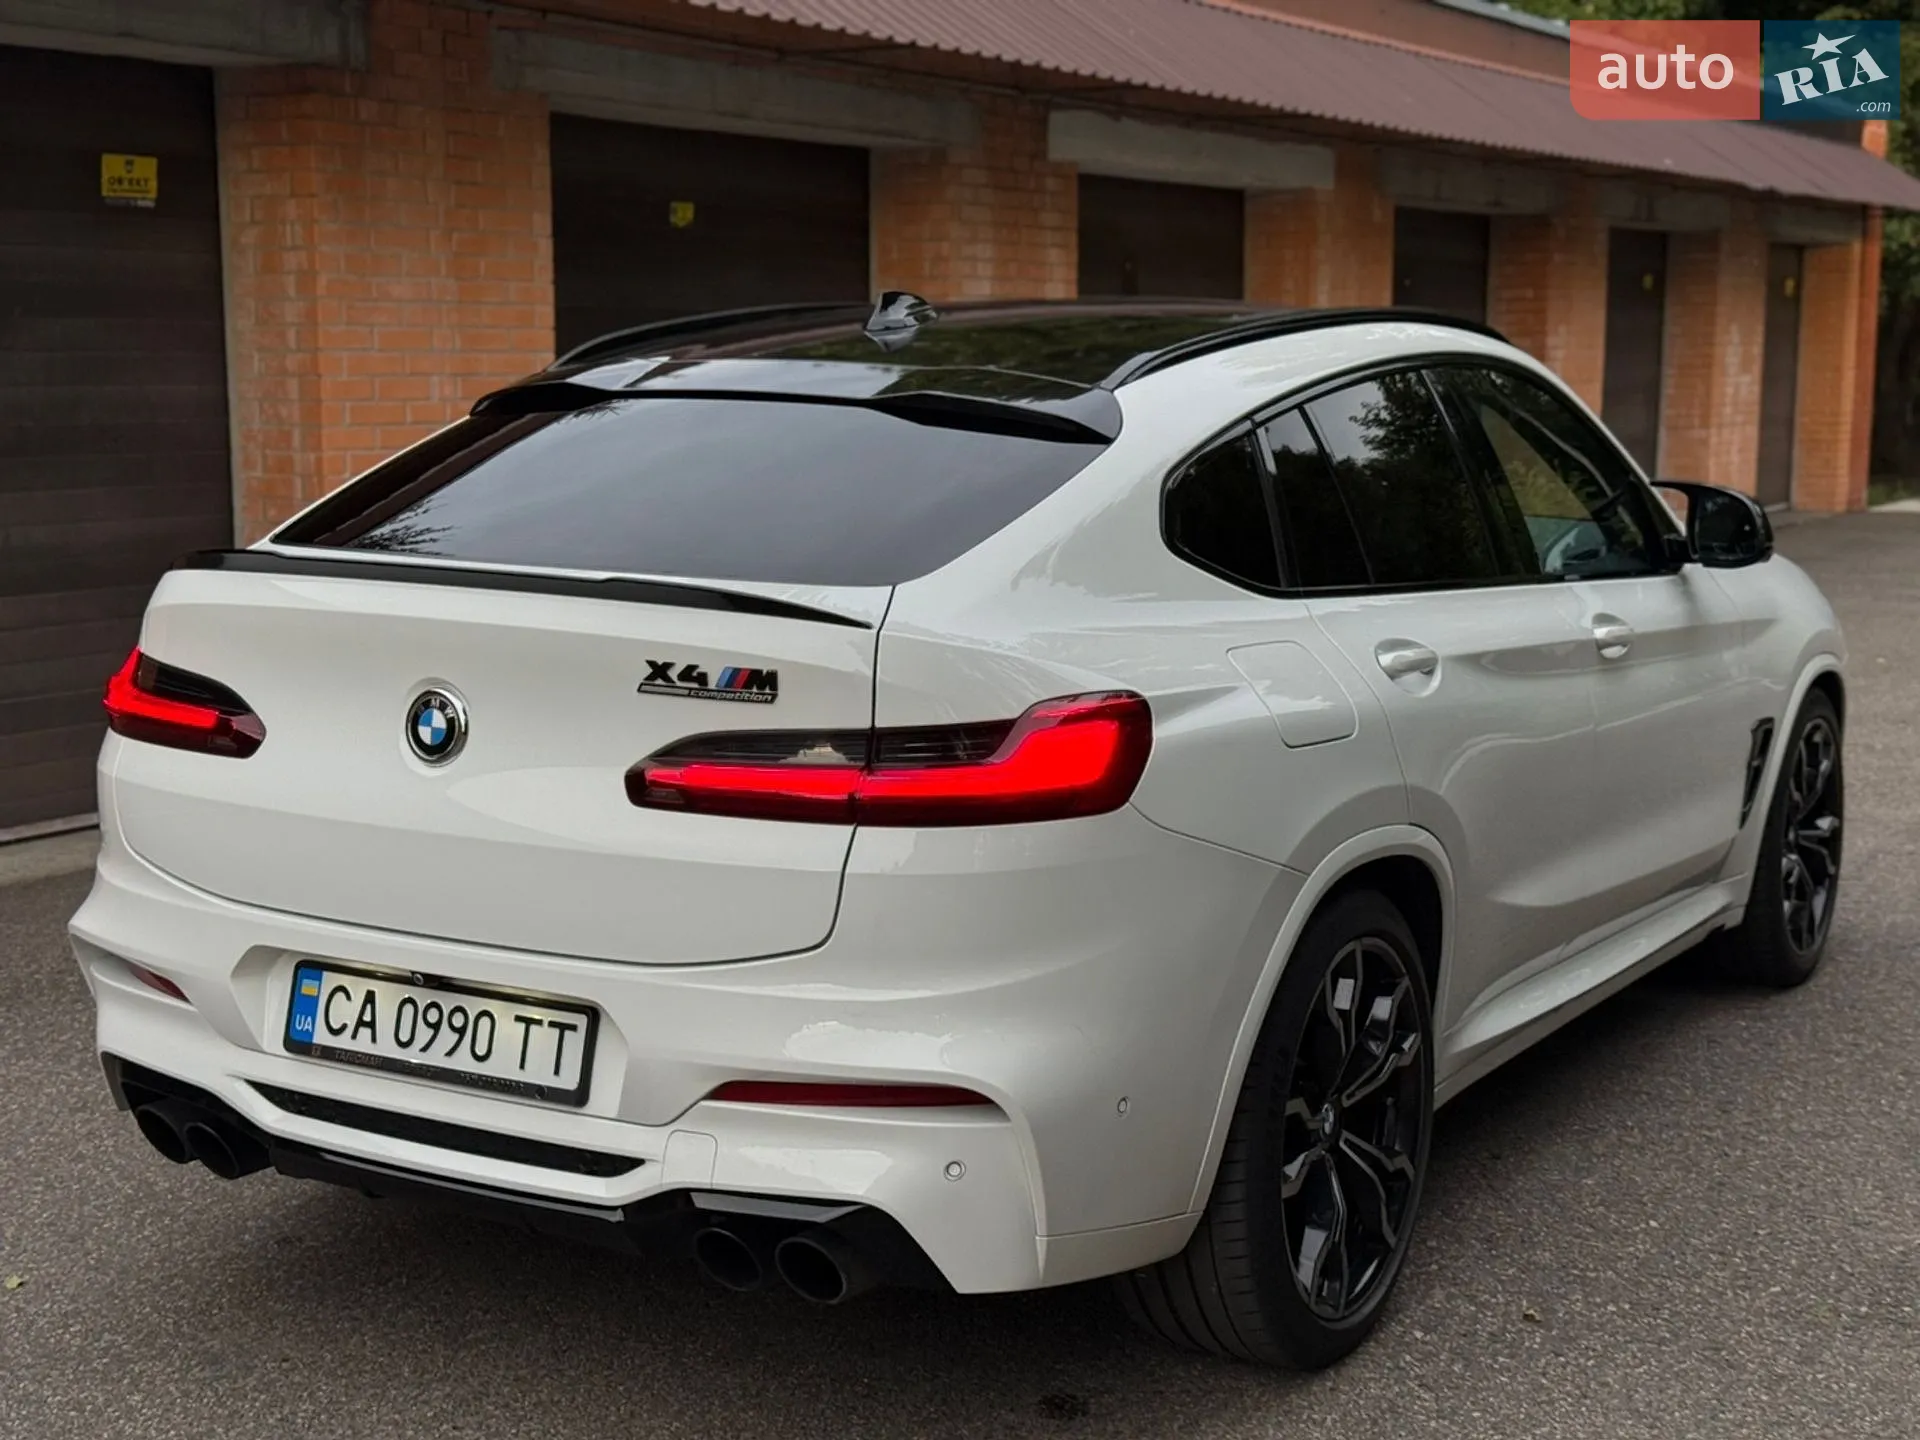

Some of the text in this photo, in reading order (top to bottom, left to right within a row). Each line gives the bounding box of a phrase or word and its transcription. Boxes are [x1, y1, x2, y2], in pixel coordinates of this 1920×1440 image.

[642, 659, 709, 688] X4
[690, 689, 772, 702] competition
[295, 1014, 313, 1033] UA
[324, 984, 578, 1076] CA 0990 TT
